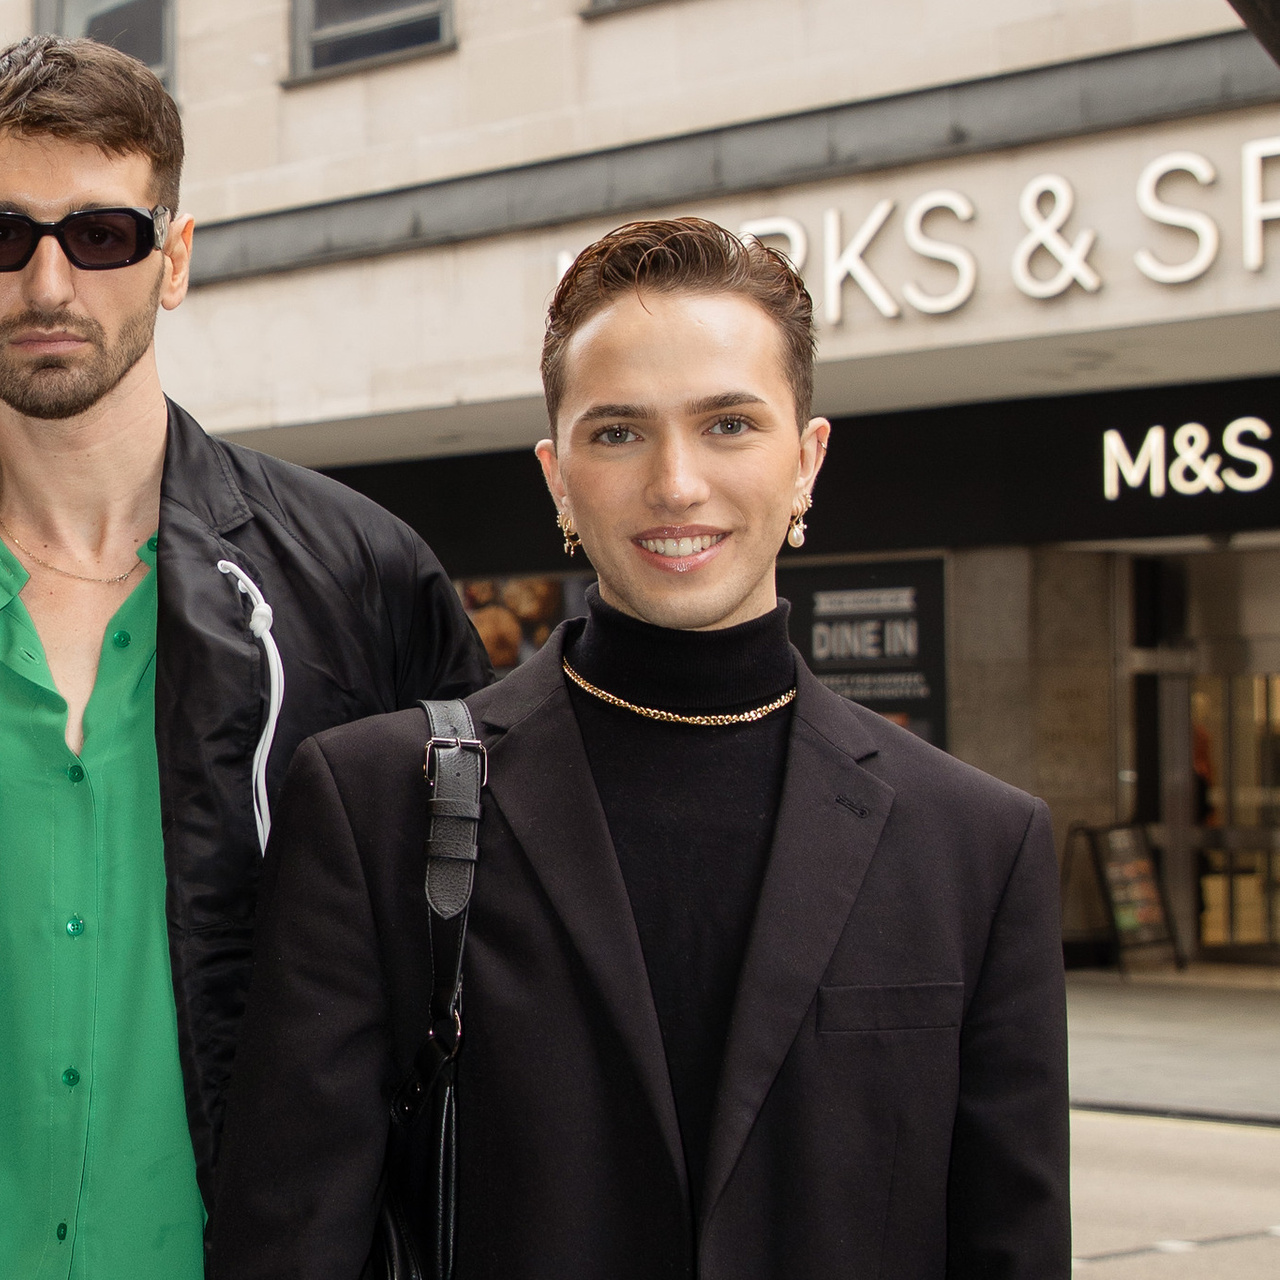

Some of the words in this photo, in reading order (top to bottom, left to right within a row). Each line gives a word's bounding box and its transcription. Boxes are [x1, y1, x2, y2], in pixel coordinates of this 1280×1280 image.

[1012, 173, 1102, 299] &
[1103, 416, 1273, 501] M&S
[813, 621, 882, 659] DINE
[884, 619, 918, 658] IN
